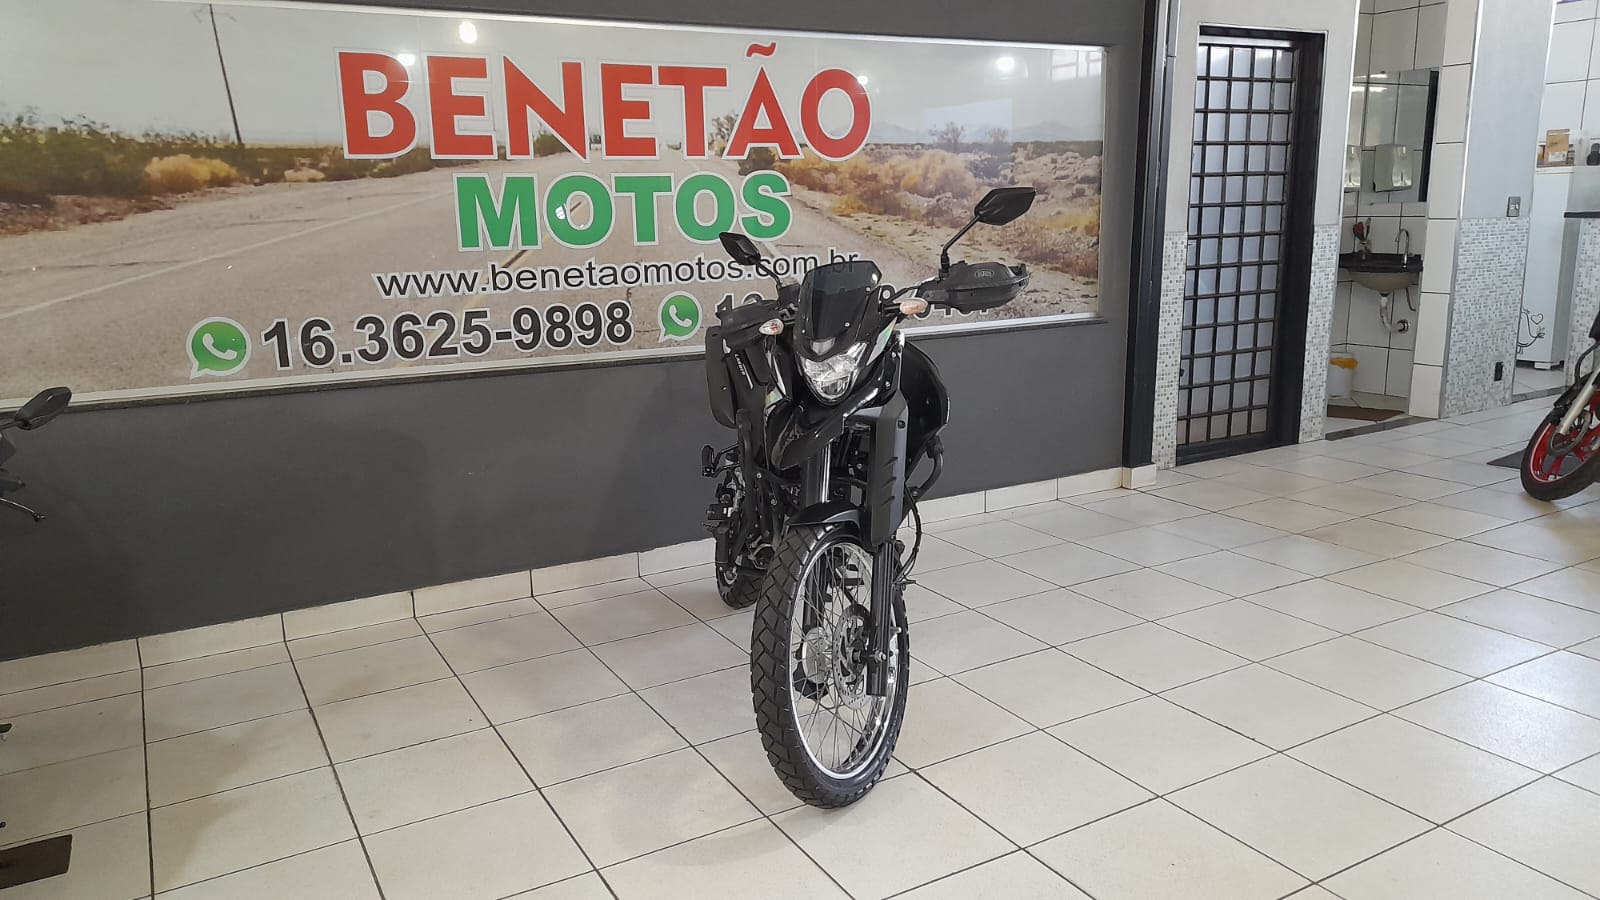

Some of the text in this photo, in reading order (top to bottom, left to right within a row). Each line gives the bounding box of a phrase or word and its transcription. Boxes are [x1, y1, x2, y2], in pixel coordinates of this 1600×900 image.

[337, 42, 871, 160] BENETÃO
[456, 172, 791, 248] MOTOS
[377, 249, 858, 296] www.benetaomotos.combr
[263, 301, 631, 368] 16.3625-9898
